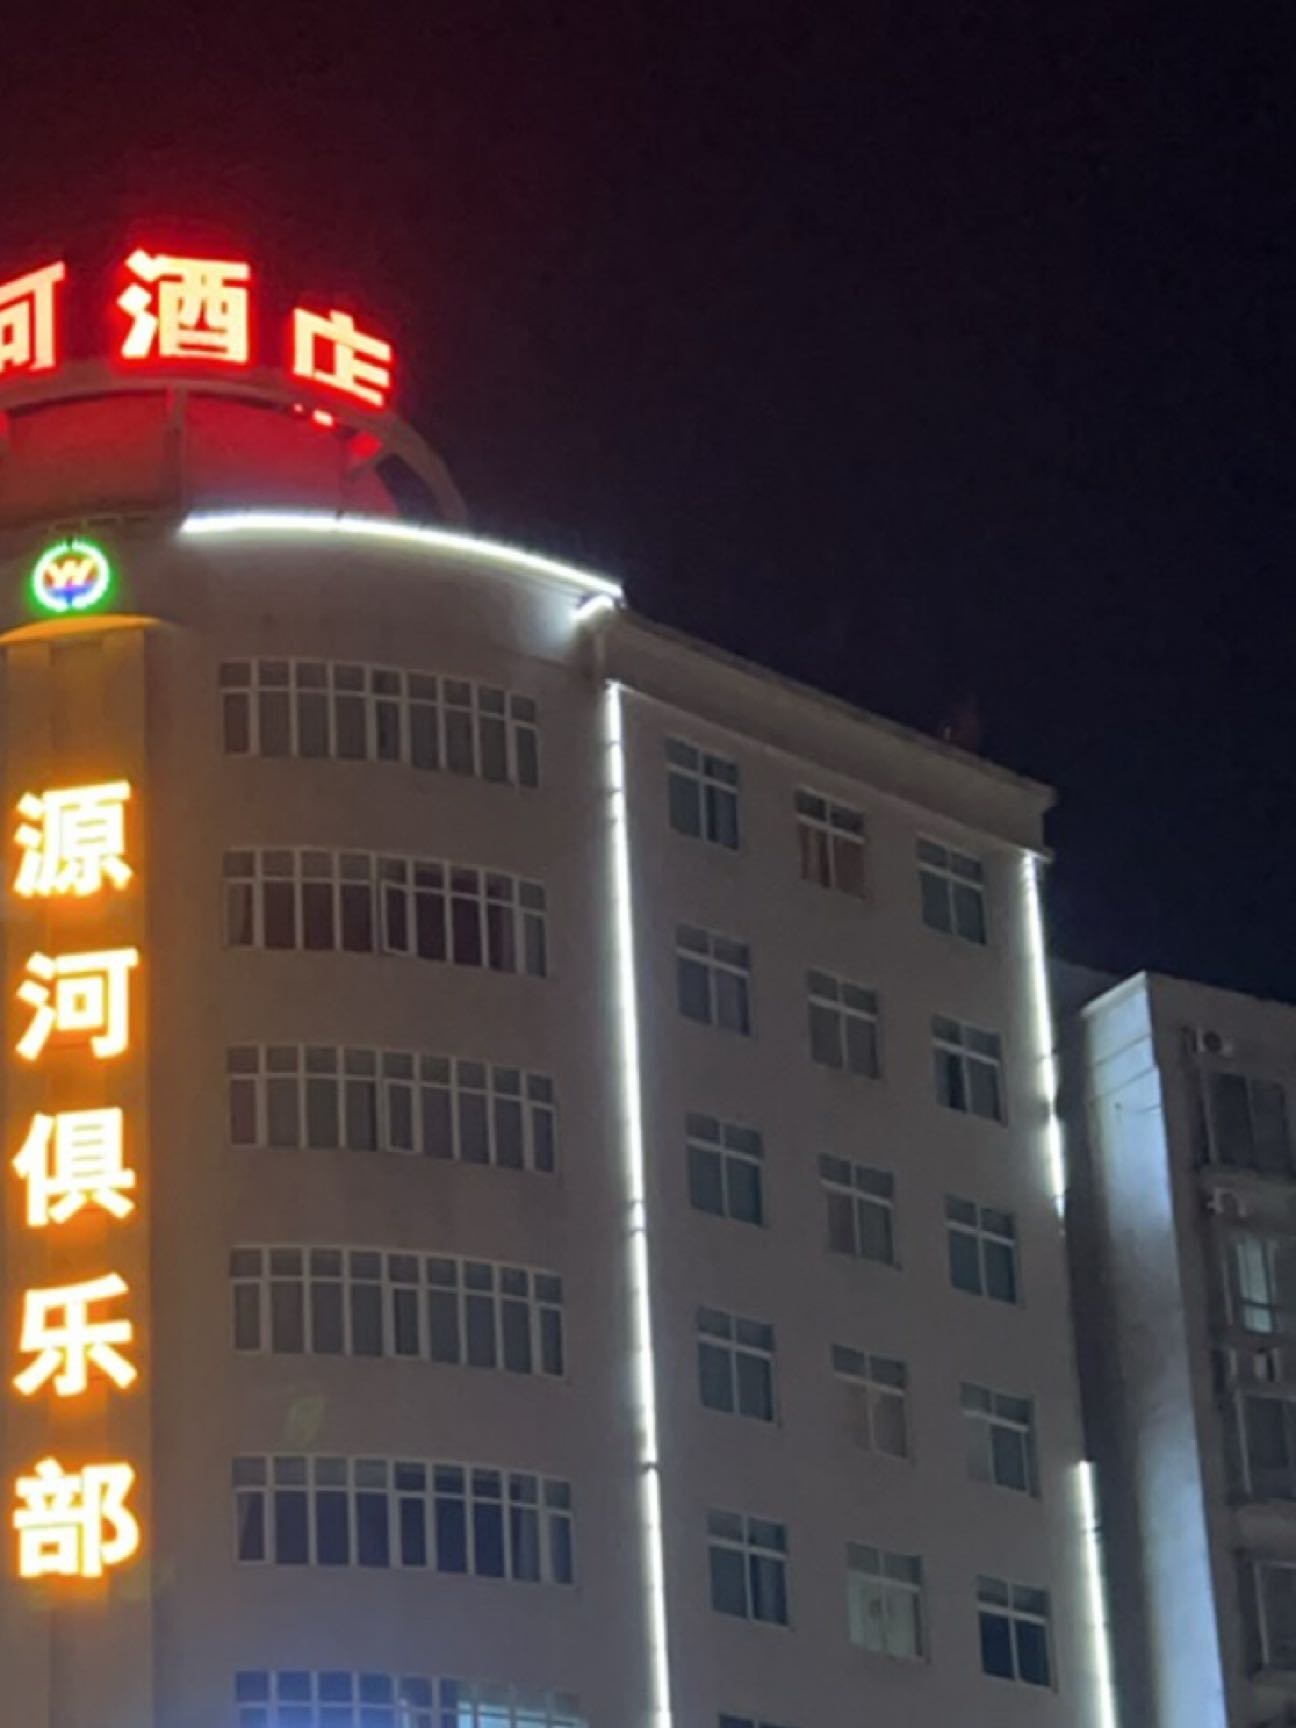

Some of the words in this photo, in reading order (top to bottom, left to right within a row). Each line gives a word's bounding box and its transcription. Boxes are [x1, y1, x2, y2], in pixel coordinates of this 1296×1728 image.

[13, 781, 140, 1577] 源河俱乐部
